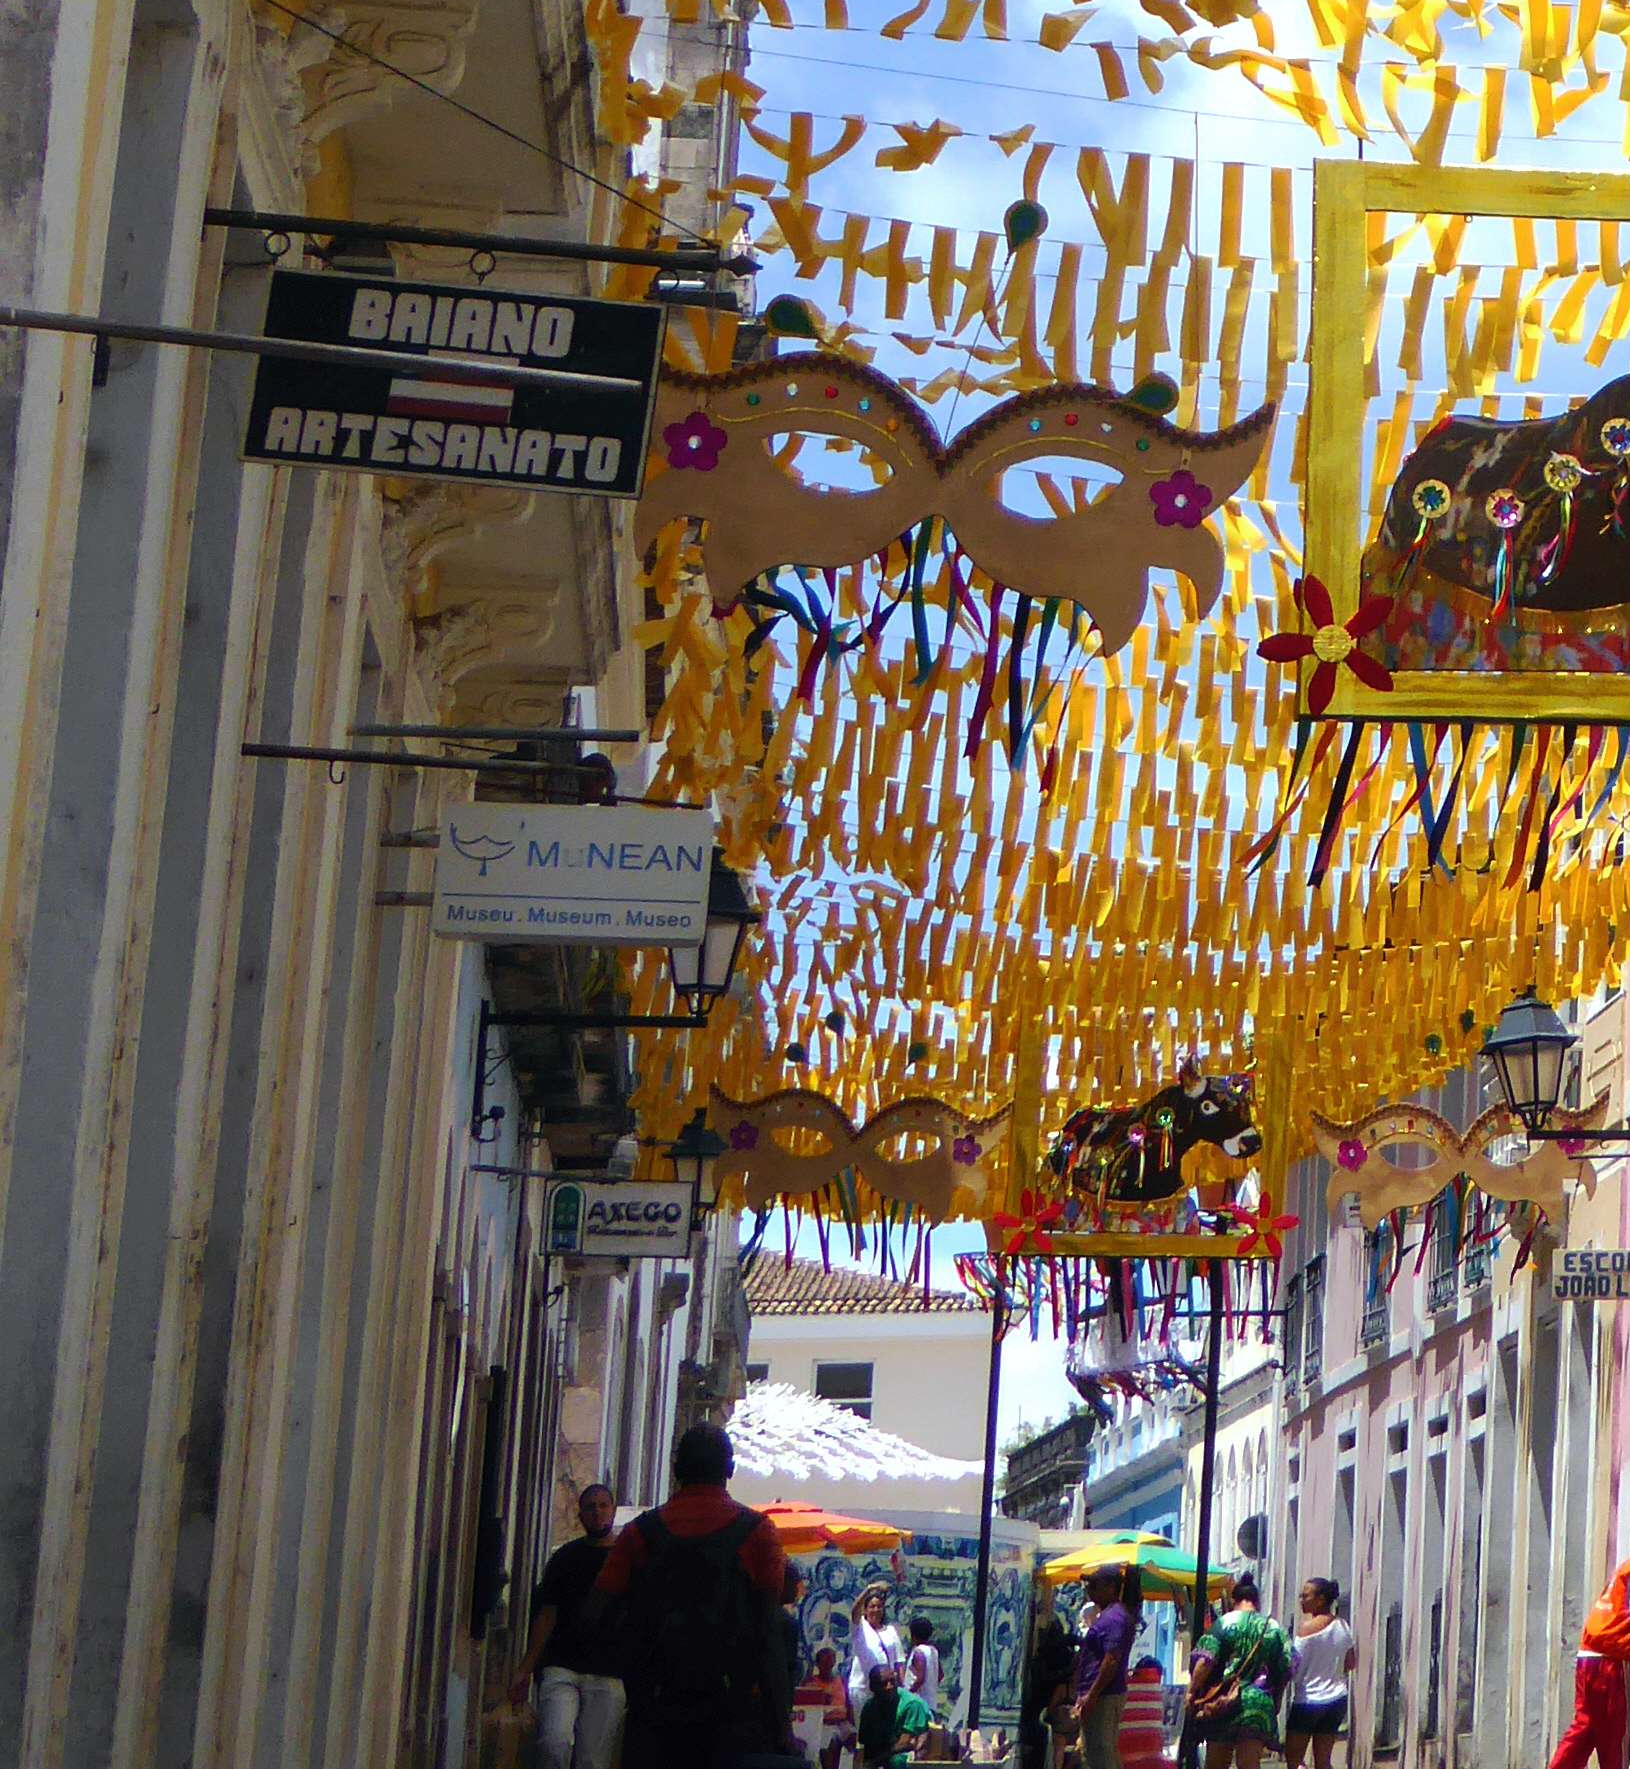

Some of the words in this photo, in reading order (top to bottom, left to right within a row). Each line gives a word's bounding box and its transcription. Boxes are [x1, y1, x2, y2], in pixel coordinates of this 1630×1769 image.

[348, 289, 575, 359] BAIANO
[264, 407, 622, 482] ARTESANATO
[447, 904, 514, 923] Museu
[527, 907, 612, 927] Museum
[625, 909, 691, 928] Museo
